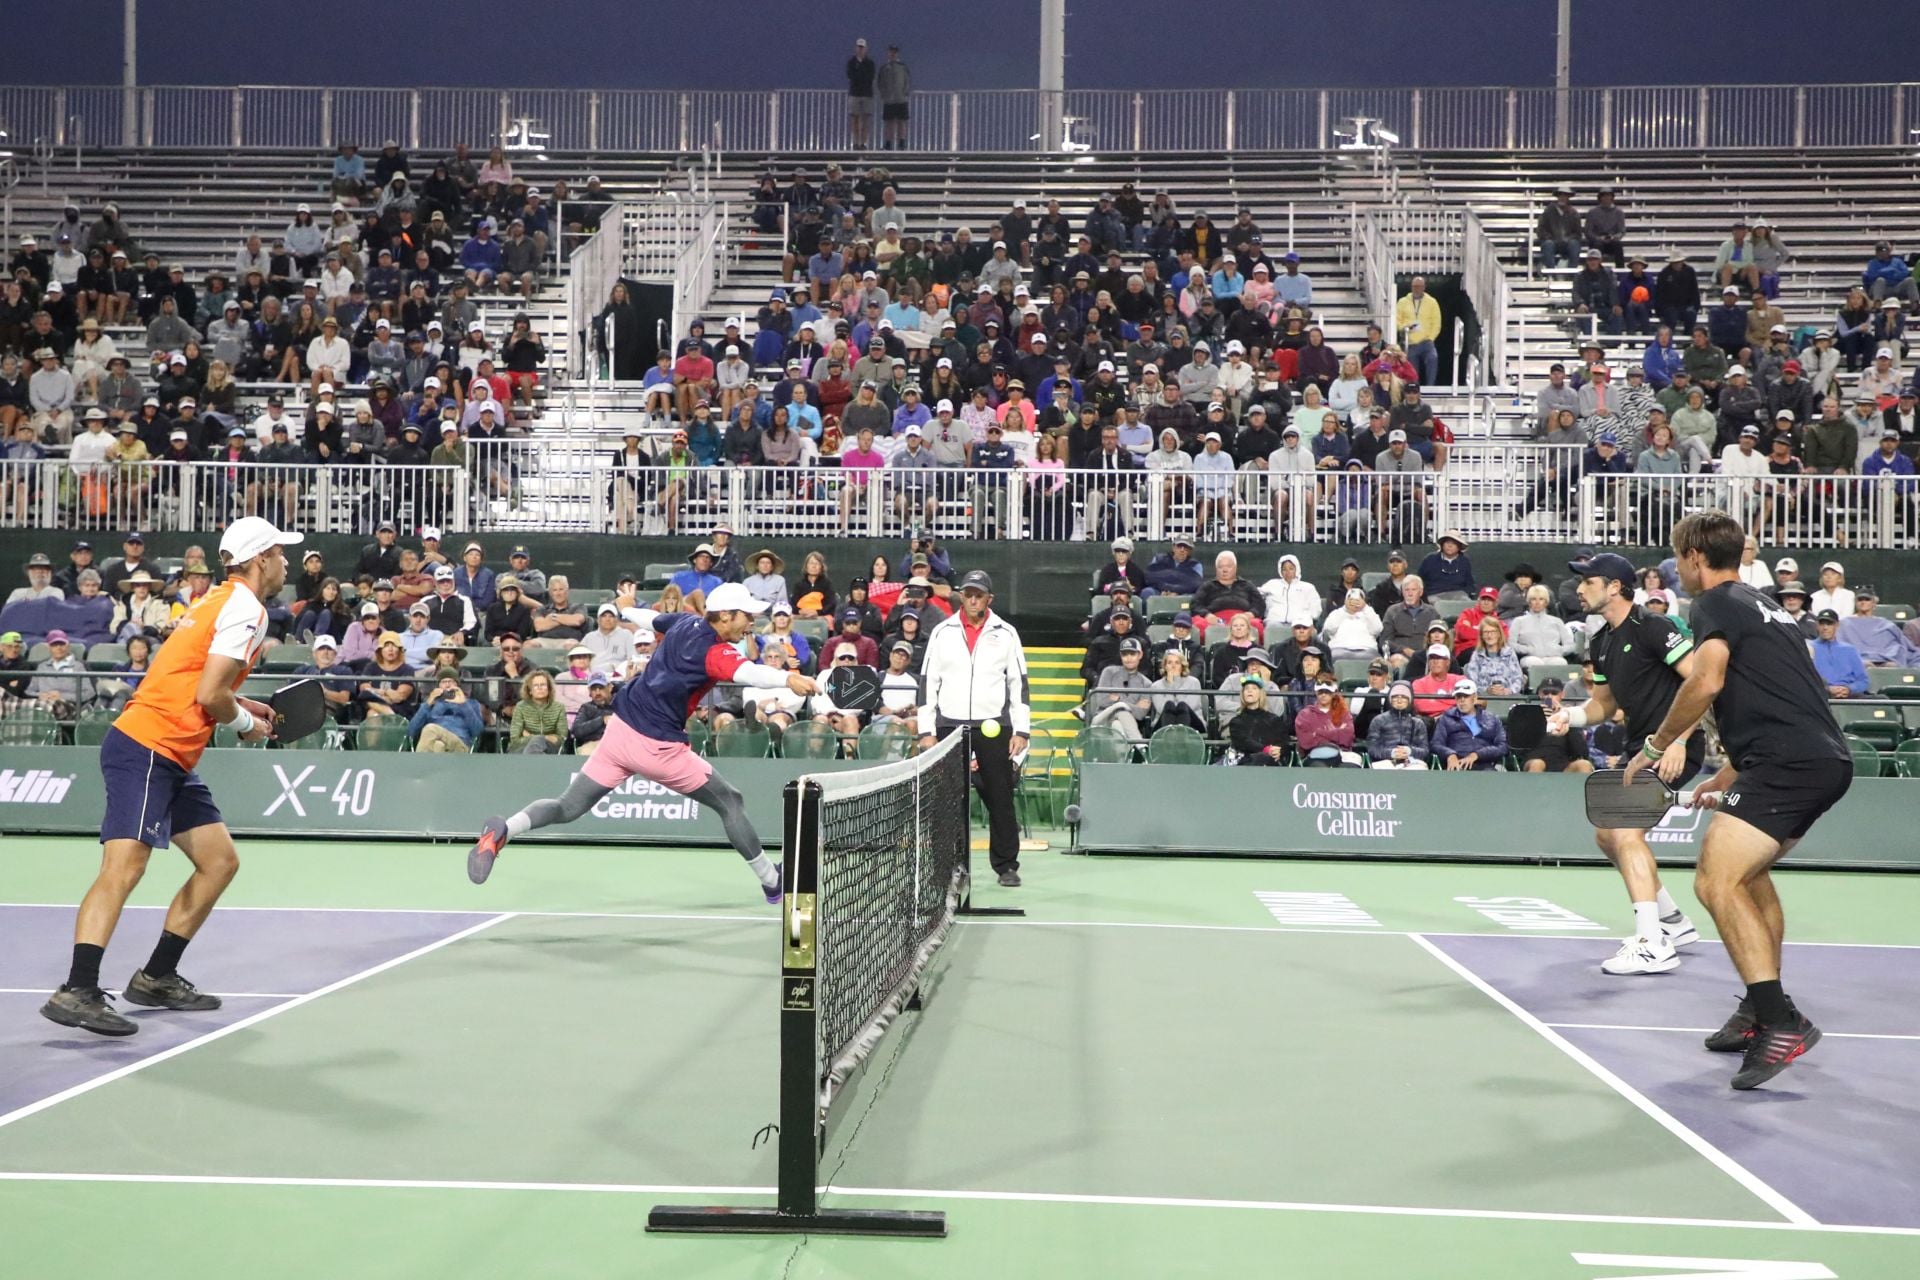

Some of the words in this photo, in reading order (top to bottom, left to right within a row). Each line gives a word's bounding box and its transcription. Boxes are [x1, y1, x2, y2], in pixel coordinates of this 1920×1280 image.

[263, 765, 375, 817] X-40
[1292, 783, 1397, 811] Consumer
[590, 797, 690, 820] Central
[1317, 810, 1397, 838] Cellular
